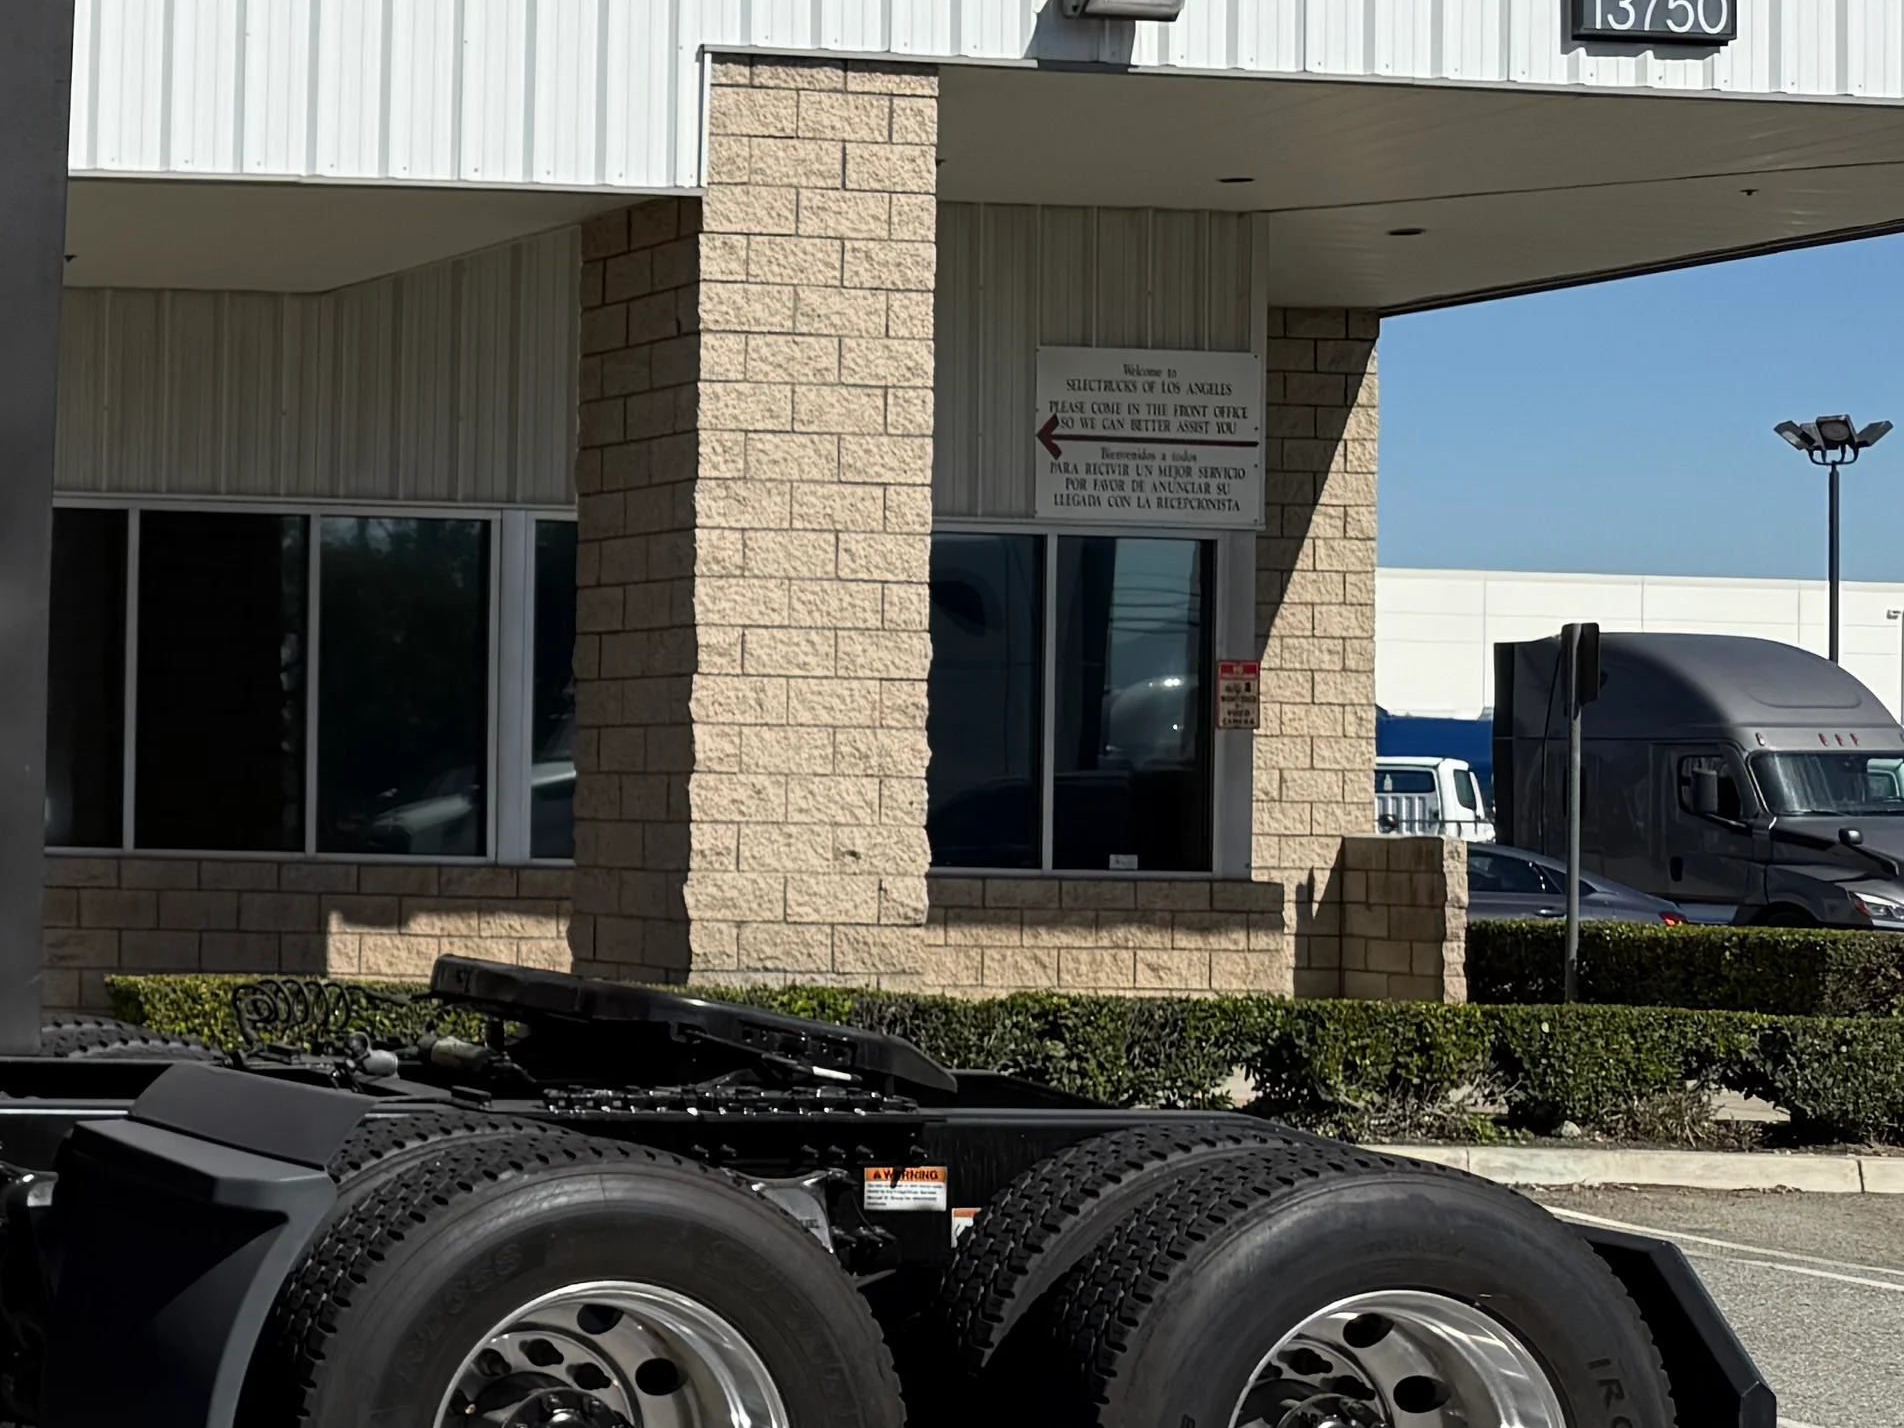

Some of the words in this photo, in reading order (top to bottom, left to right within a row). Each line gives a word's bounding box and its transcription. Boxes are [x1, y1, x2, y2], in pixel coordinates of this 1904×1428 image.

[1124, 364, 1161, 377] Welcome
[1167, 369, 1177, 378] to
[1143, 381, 1155, 393] OF
[1161, 381, 1180, 394] LOS
[1186, 382, 1232, 395] ANGELES
[1049, 401, 1086, 414] PLEASE
[1091, 402, 1121, 415] COME
[1127, 403, 1140, 415] IN
[1146, 404, 1167, 416] THE
[1174, 404, 1208, 417] FRONT
[1214, 406, 1248, 419] OFFICE
[1060, 417, 1074, 429] SO
[1081, 417, 1095, 429] WE
[1102, 418, 1124, 430] CAN
[1131, 419, 1170, 432] BETTER
[1177, 420, 1209, 433] ASSIST
[1217, 422, 1236, 435] YOU
[1101, 448, 1155, 461] Bienvenidos
[1161, 452, 1166, 461] a
[1172, 450, 1197, 462] todos
[1050, 462, 1079, 474] PARA
[1136, 464, 1152, 477] UN
[1159, 465, 1192, 480] MEJOR
[1199, 466, 1245, 480] SERVICIO
[1065, 478, 1087, 490] POR
[1093, 479, 1125, 492] FAVOR
[1132, 480, 1145, 492] DE
[1152, 481, 1211, 495] ANUNCIAR
[1217, 482, 1230, 495] SU
[1054, 494, 1101, 507] LLEGADA
[1108, 495, 1131, 508] CON
[1137, 496, 1151, 509] LA
[1157, 497, 1240, 511] RECEPCIONISTA
[883, 1169, 939, 1180] WRNING
